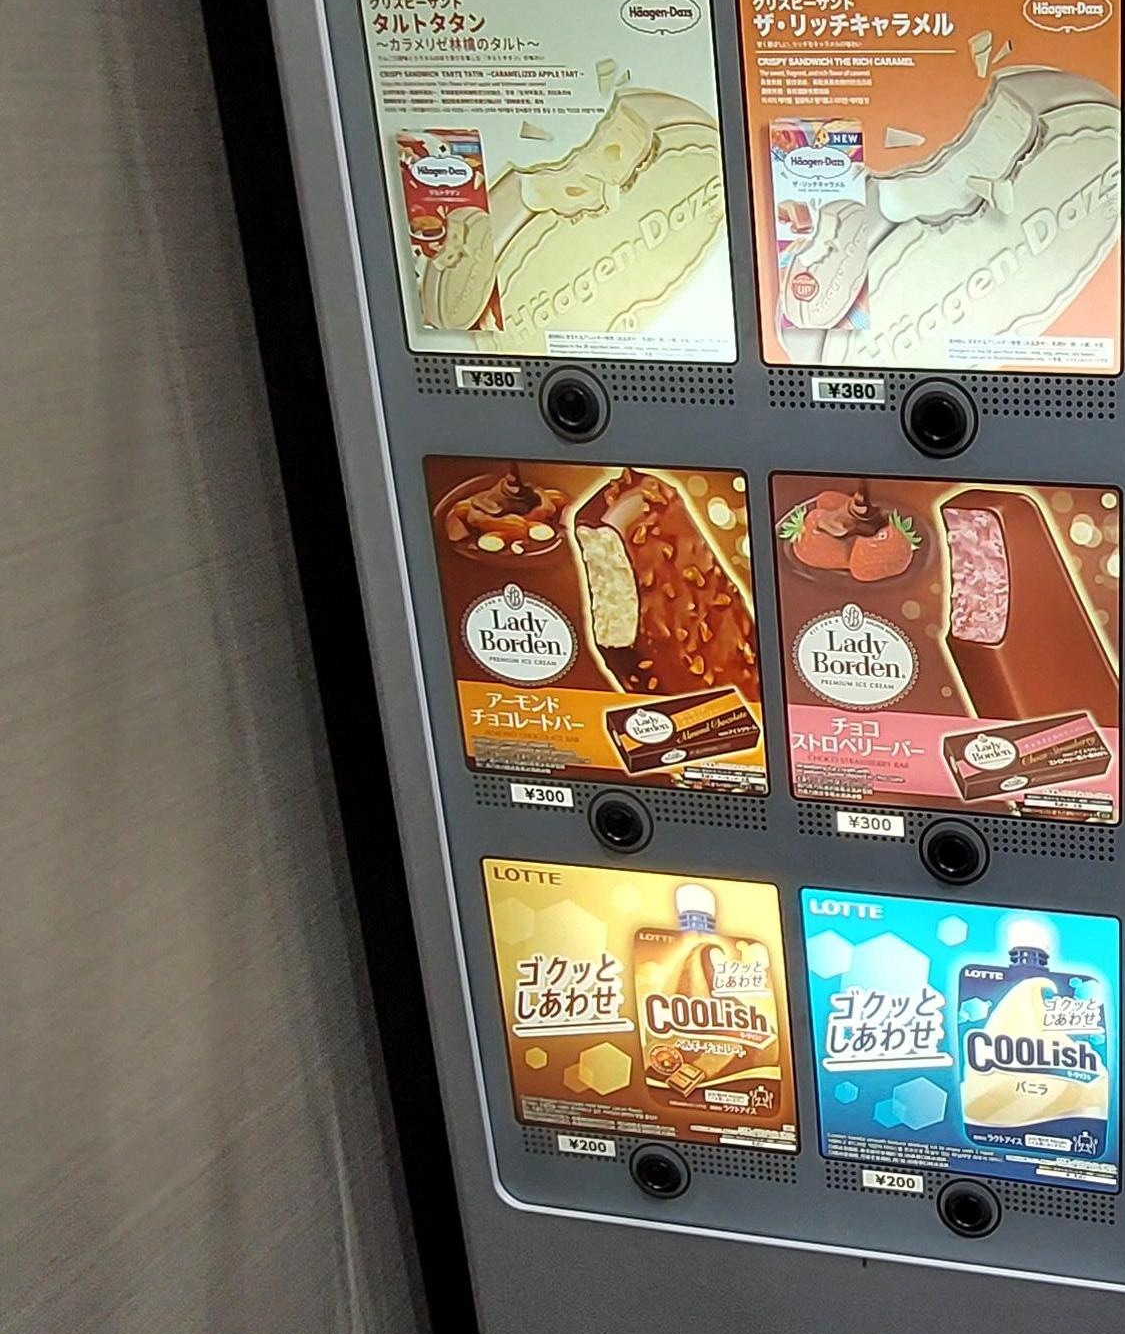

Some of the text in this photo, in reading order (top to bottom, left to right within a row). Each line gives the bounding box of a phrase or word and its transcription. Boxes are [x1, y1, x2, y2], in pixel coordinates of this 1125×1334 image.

[629, 6, 693, 20] Häagen-Dazs
[1032, 2, 1103, 16] Häagen-Dazs
[372, 12, 485, 35] タルトタタン
[753, 13, 954, 37] ザ・リッチキャラメル
[757, 57, 915, 67] CRISPY SANDWICH THE RICH CARAMEL
[833, 134, 858, 143] NEW
[471, 372, 515, 387] ¥380
[828, 383, 875, 399] ¥380
[489, 609, 548, 638] Lady
[479, 629, 562, 656] Borden
[826, 630, 889, 660] Lady
[812, 651, 901, 679] Borden
[487, 692, 560, 714] アーモンド
[470, 708, 585, 731] チョコレートバー
[635, 716, 659, 728] Lady
[831, 717, 880, 738] チョコ
[792, 734, 925, 758] ストロベリーバー
[975, 742, 1001, 753] Lady
[525, 787, 565, 804] ¥300
[848, 815, 892, 832] ¥300
[494, 867, 562, 885] LOTTE
[809, 899, 884, 919] LOTTE
[519, 953, 616, 987] ゴクッと
[716, 961, 763, 974] ゴクッと
[964, 969, 1003, 980] LOTTE
[715, 975, 762, 988] しあわせ
[517, 986, 617, 1020] しあわせ
[833, 988, 936, 1019] ゴクッと
[1045, 998, 1097, 1012] ゴクッと
[1043, 1013, 1095, 1026] しあわせ
[830, 1020, 935, 1053] しあわせ
[1016, 1081, 1048, 1095] バニラ
[569, 1138, 607, 1152] ¥200
[987, 1134, 1022, 1145] ラクトアイス
[875, 1175, 915, 1189] ¥200
